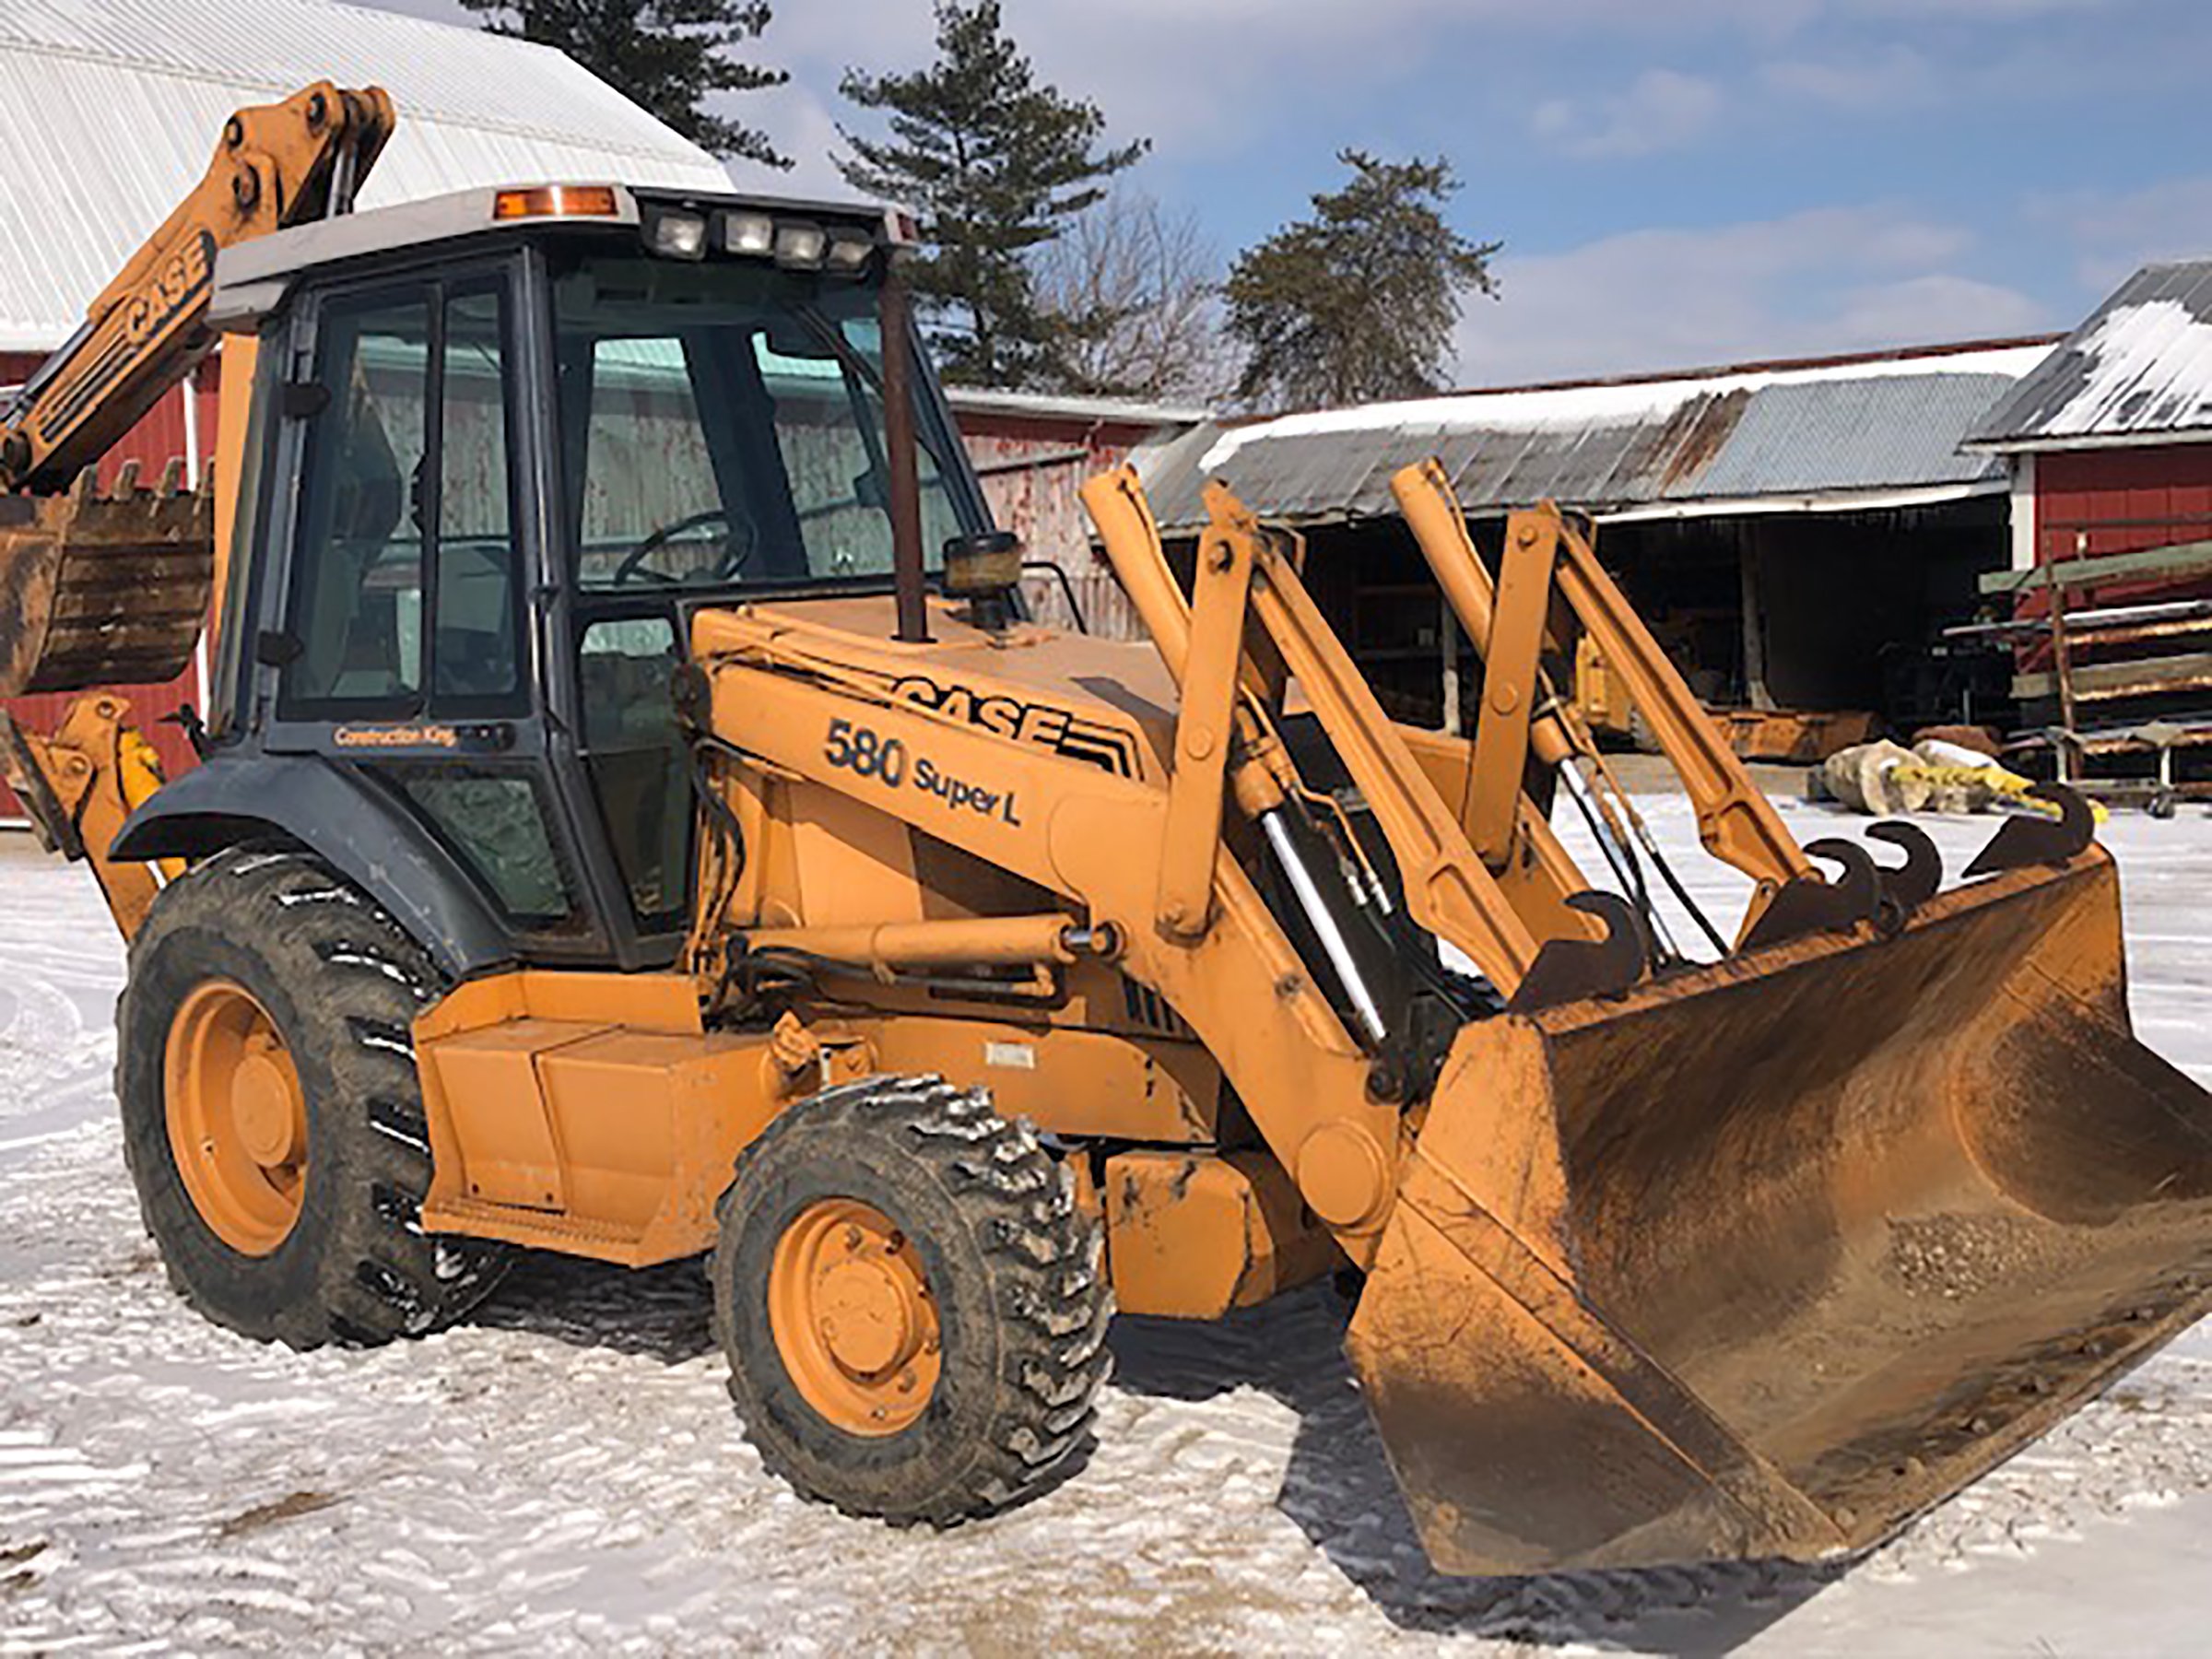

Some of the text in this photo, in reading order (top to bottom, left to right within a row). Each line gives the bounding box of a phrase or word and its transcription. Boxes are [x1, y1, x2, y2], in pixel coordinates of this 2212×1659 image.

[126, 235, 208, 344] CASE
[424, 725, 457, 747] King
[891, 677, 1070, 754] CASE
[825, 718, 1020, 827] 580 Super L
